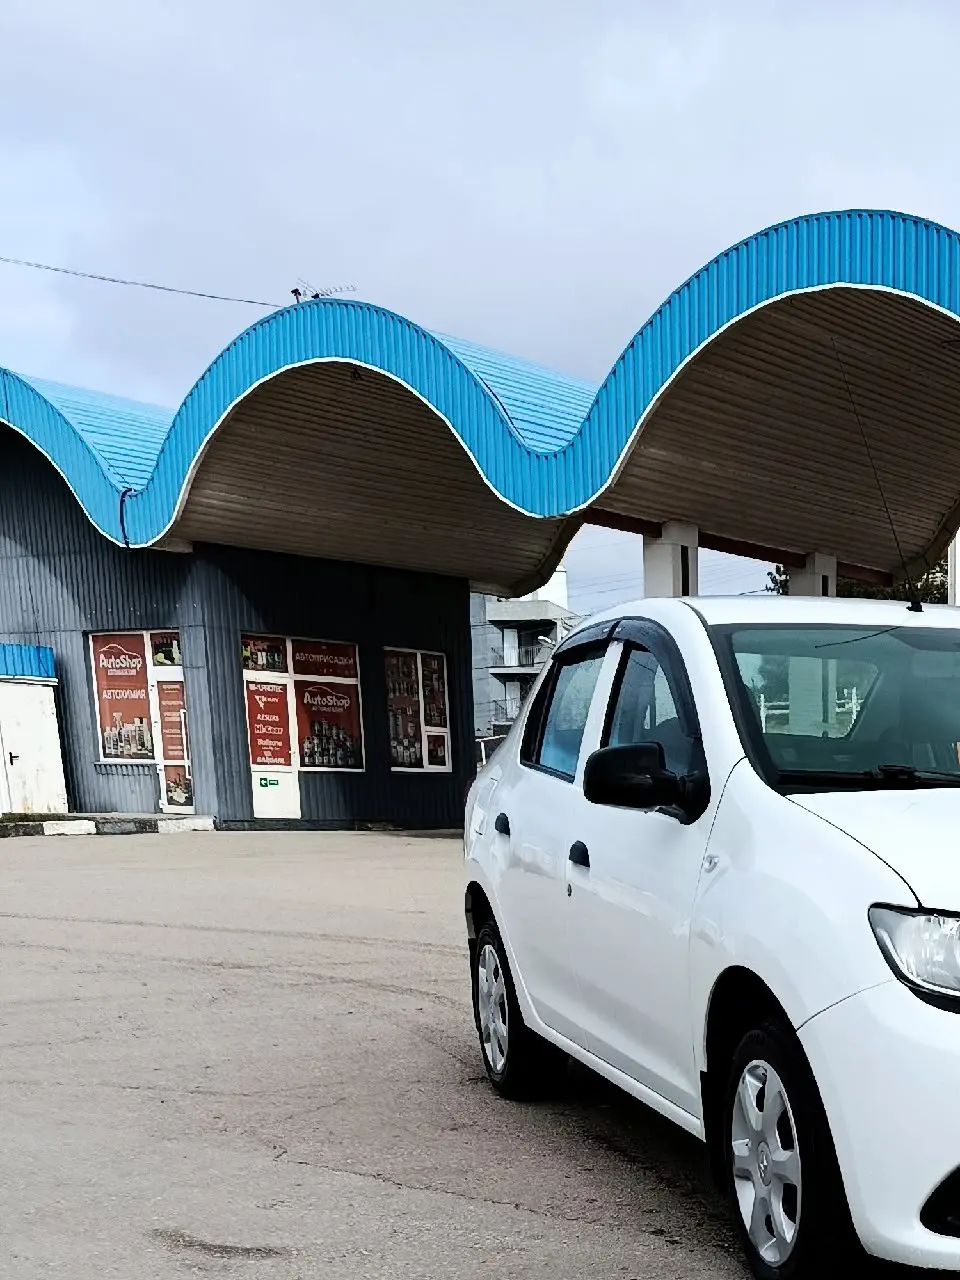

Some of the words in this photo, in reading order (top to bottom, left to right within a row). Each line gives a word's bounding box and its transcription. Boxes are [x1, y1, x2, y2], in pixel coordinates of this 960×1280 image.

[100, 653, 142, 671] AutoShop
[295, 652, 354, 665] АВТОПРИСАДКИ
[102, 689, 146, 699] АВТОХИМИЯ
[303, 691, 351, 709] AutoShop
